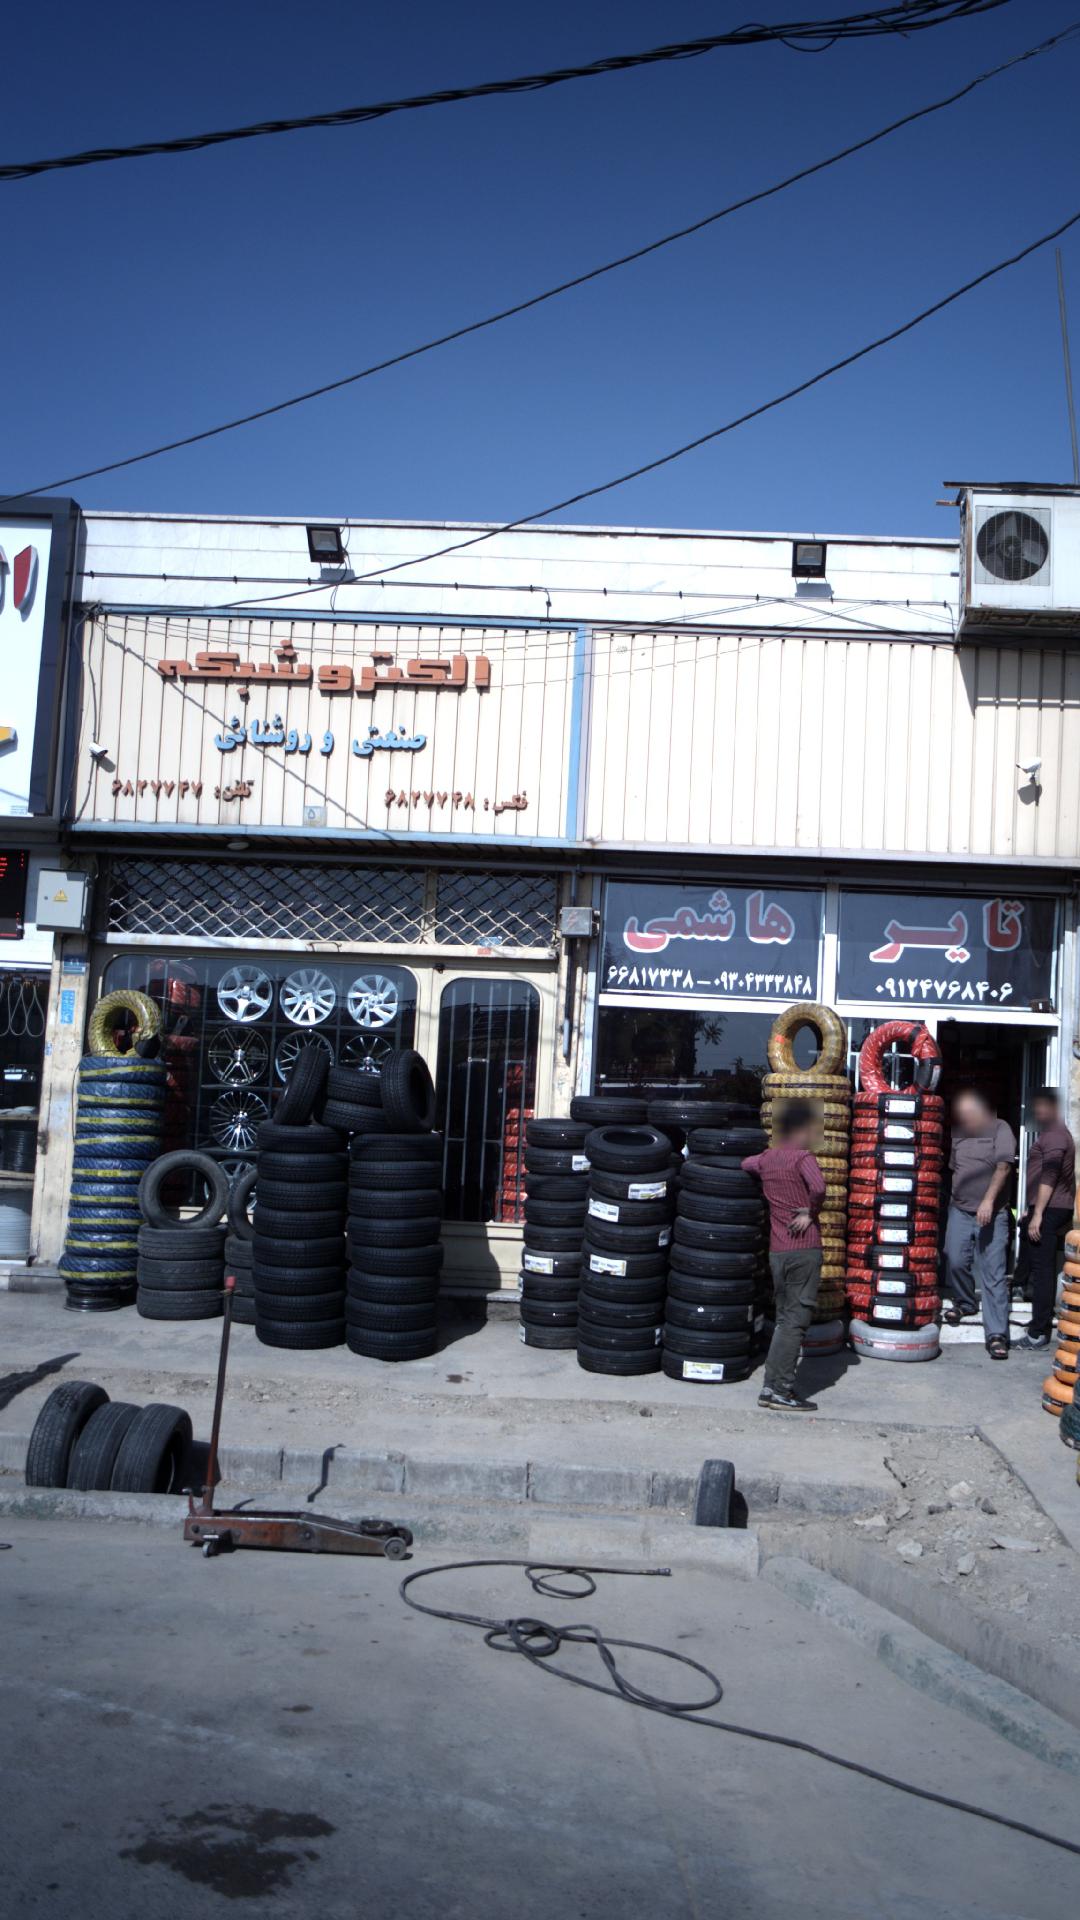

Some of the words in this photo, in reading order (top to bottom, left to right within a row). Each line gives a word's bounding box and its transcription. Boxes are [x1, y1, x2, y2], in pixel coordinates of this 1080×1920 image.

[158, 639, 491, 701] الکتروشبکه
[319, 730, 335, 756] و
[352, 724, 427, 757] صنعتی
[624, 889, 795, 953] هاشمی
[875, 977, 1013, 1002] ۰۹۱۲۴۷۶۸۴۰۶
